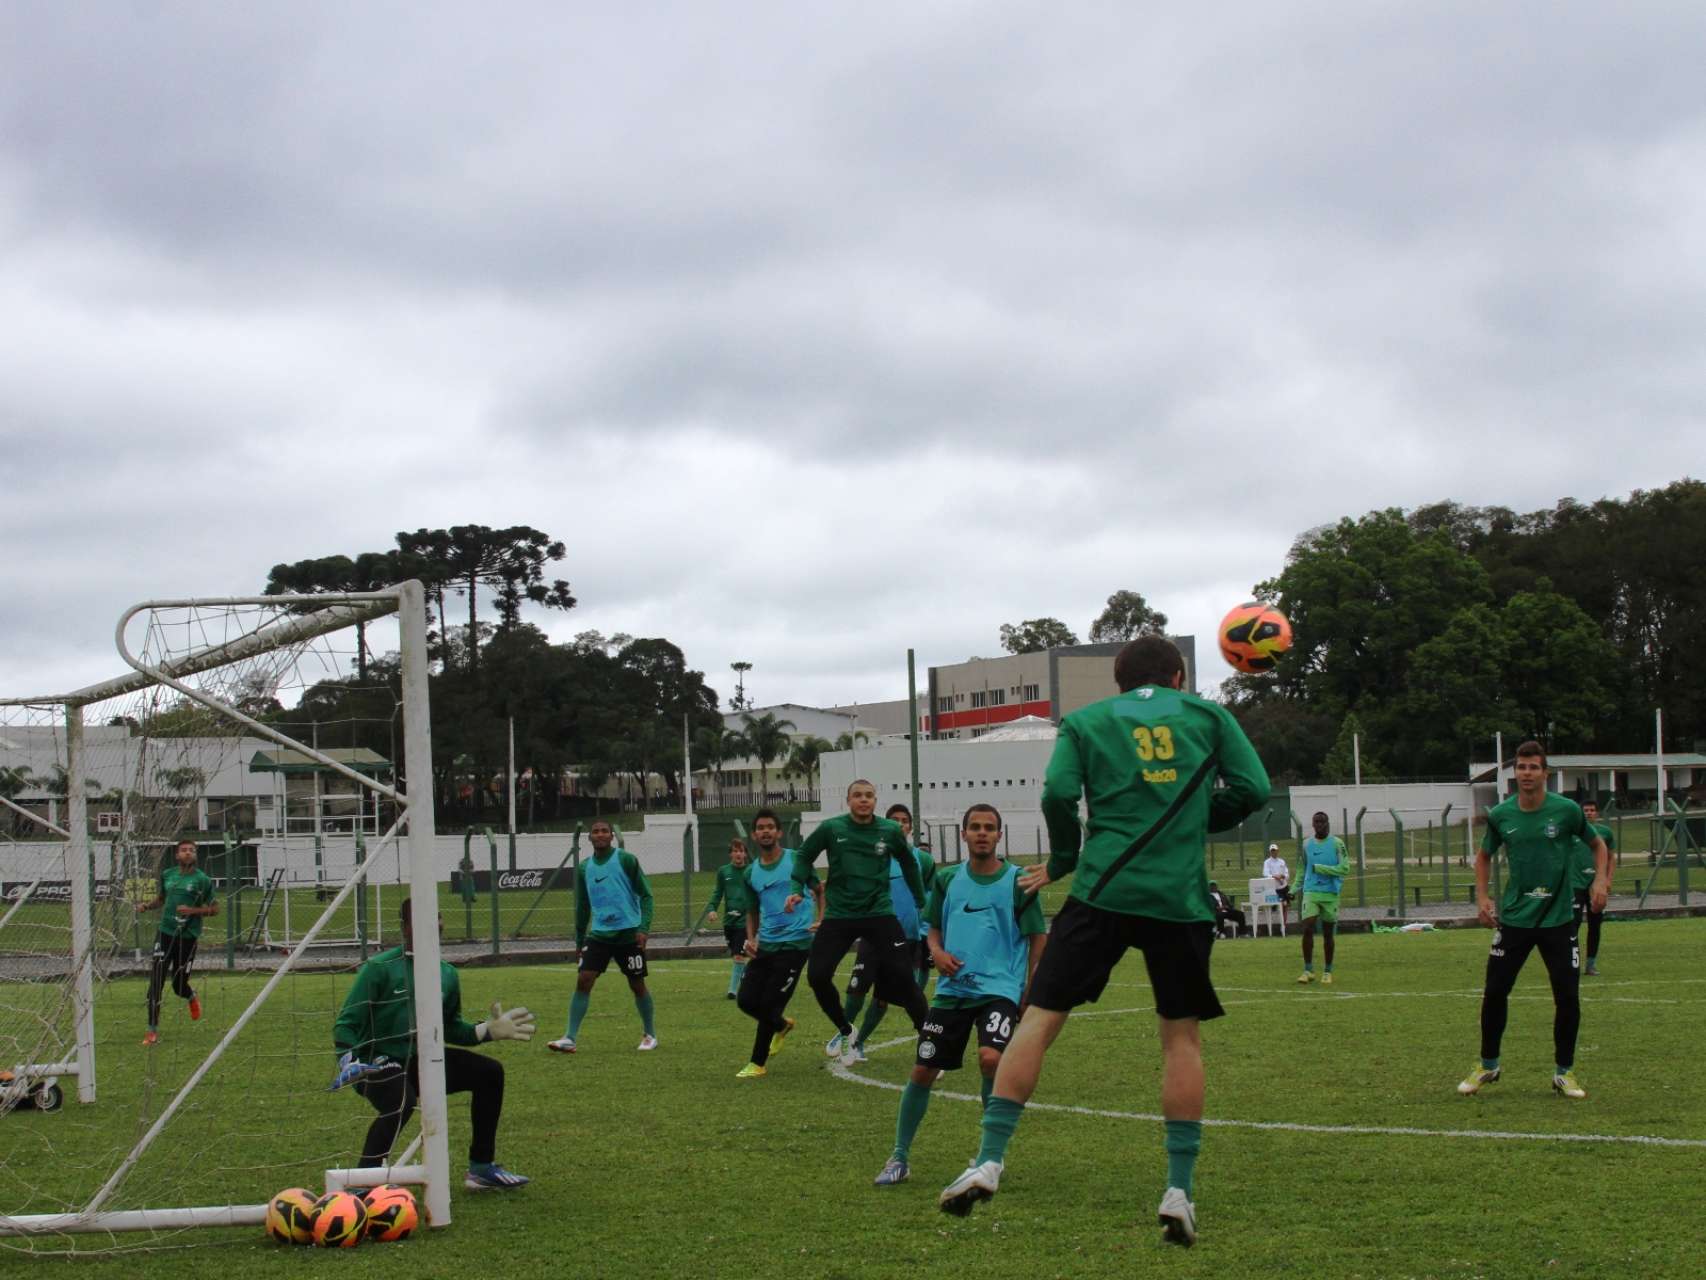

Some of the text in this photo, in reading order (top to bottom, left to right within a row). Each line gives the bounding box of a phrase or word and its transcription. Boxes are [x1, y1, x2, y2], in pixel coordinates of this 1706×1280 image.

[1132, 725, 1175, 761] 33
[498, 871, 544, 888] Coca-Cola
[627, 954, 643, 970] 30
[1571, 946, 1580, 969] 5
[985, 1011, 1011, 1038] 36
